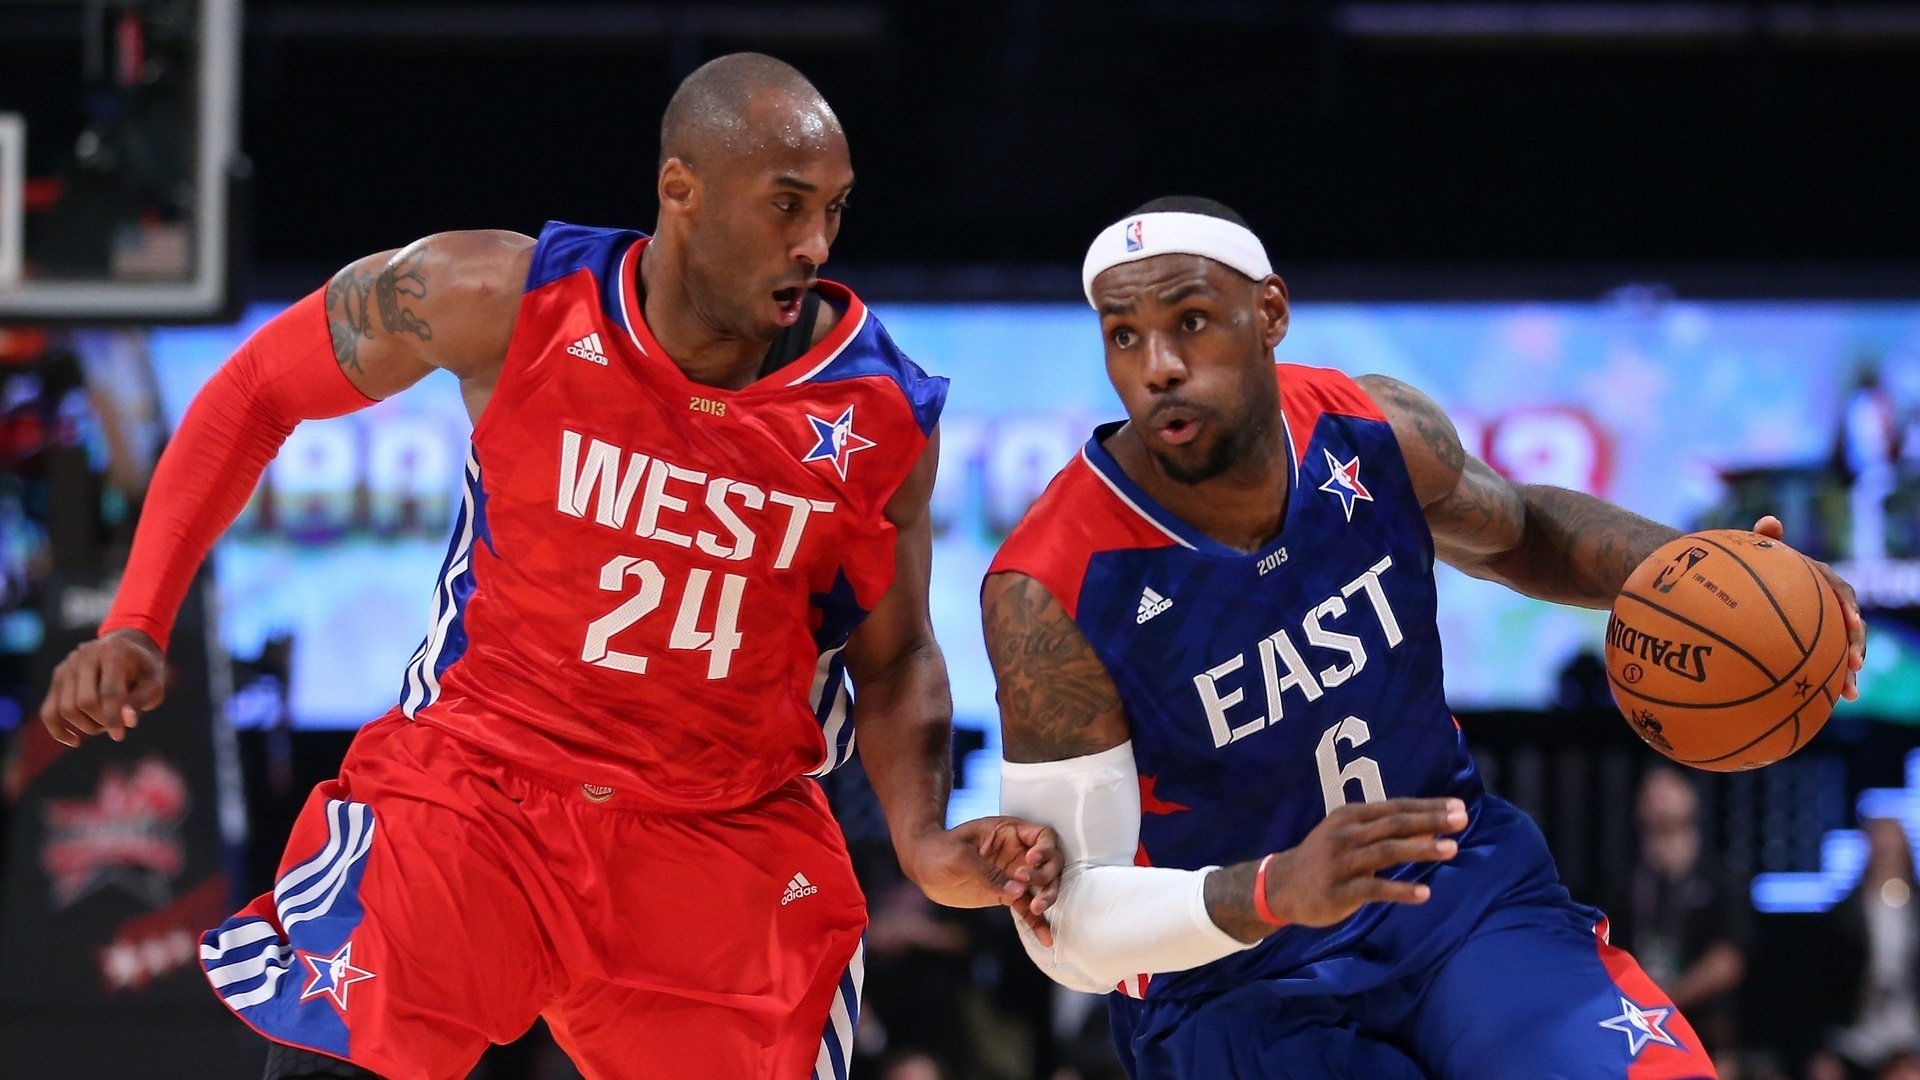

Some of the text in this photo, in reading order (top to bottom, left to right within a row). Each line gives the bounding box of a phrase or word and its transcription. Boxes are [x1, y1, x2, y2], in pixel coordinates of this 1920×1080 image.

[566, 346, 609, 366] adidas
[689, 396, 727, 417] 2013
[557, 429, 837, 570] WEST
[1257, 547, 1289, 576] 2013
[580, 554, 748, 680] 24
[1136, 598, 1174, 625] adidas
[1193, 554, 1404, 749] EAST
[1605, 612, 1713, 683] SPALDIN
[1315, 715, 1388, 820] 6
[781, 885, 818, 906] adidas
